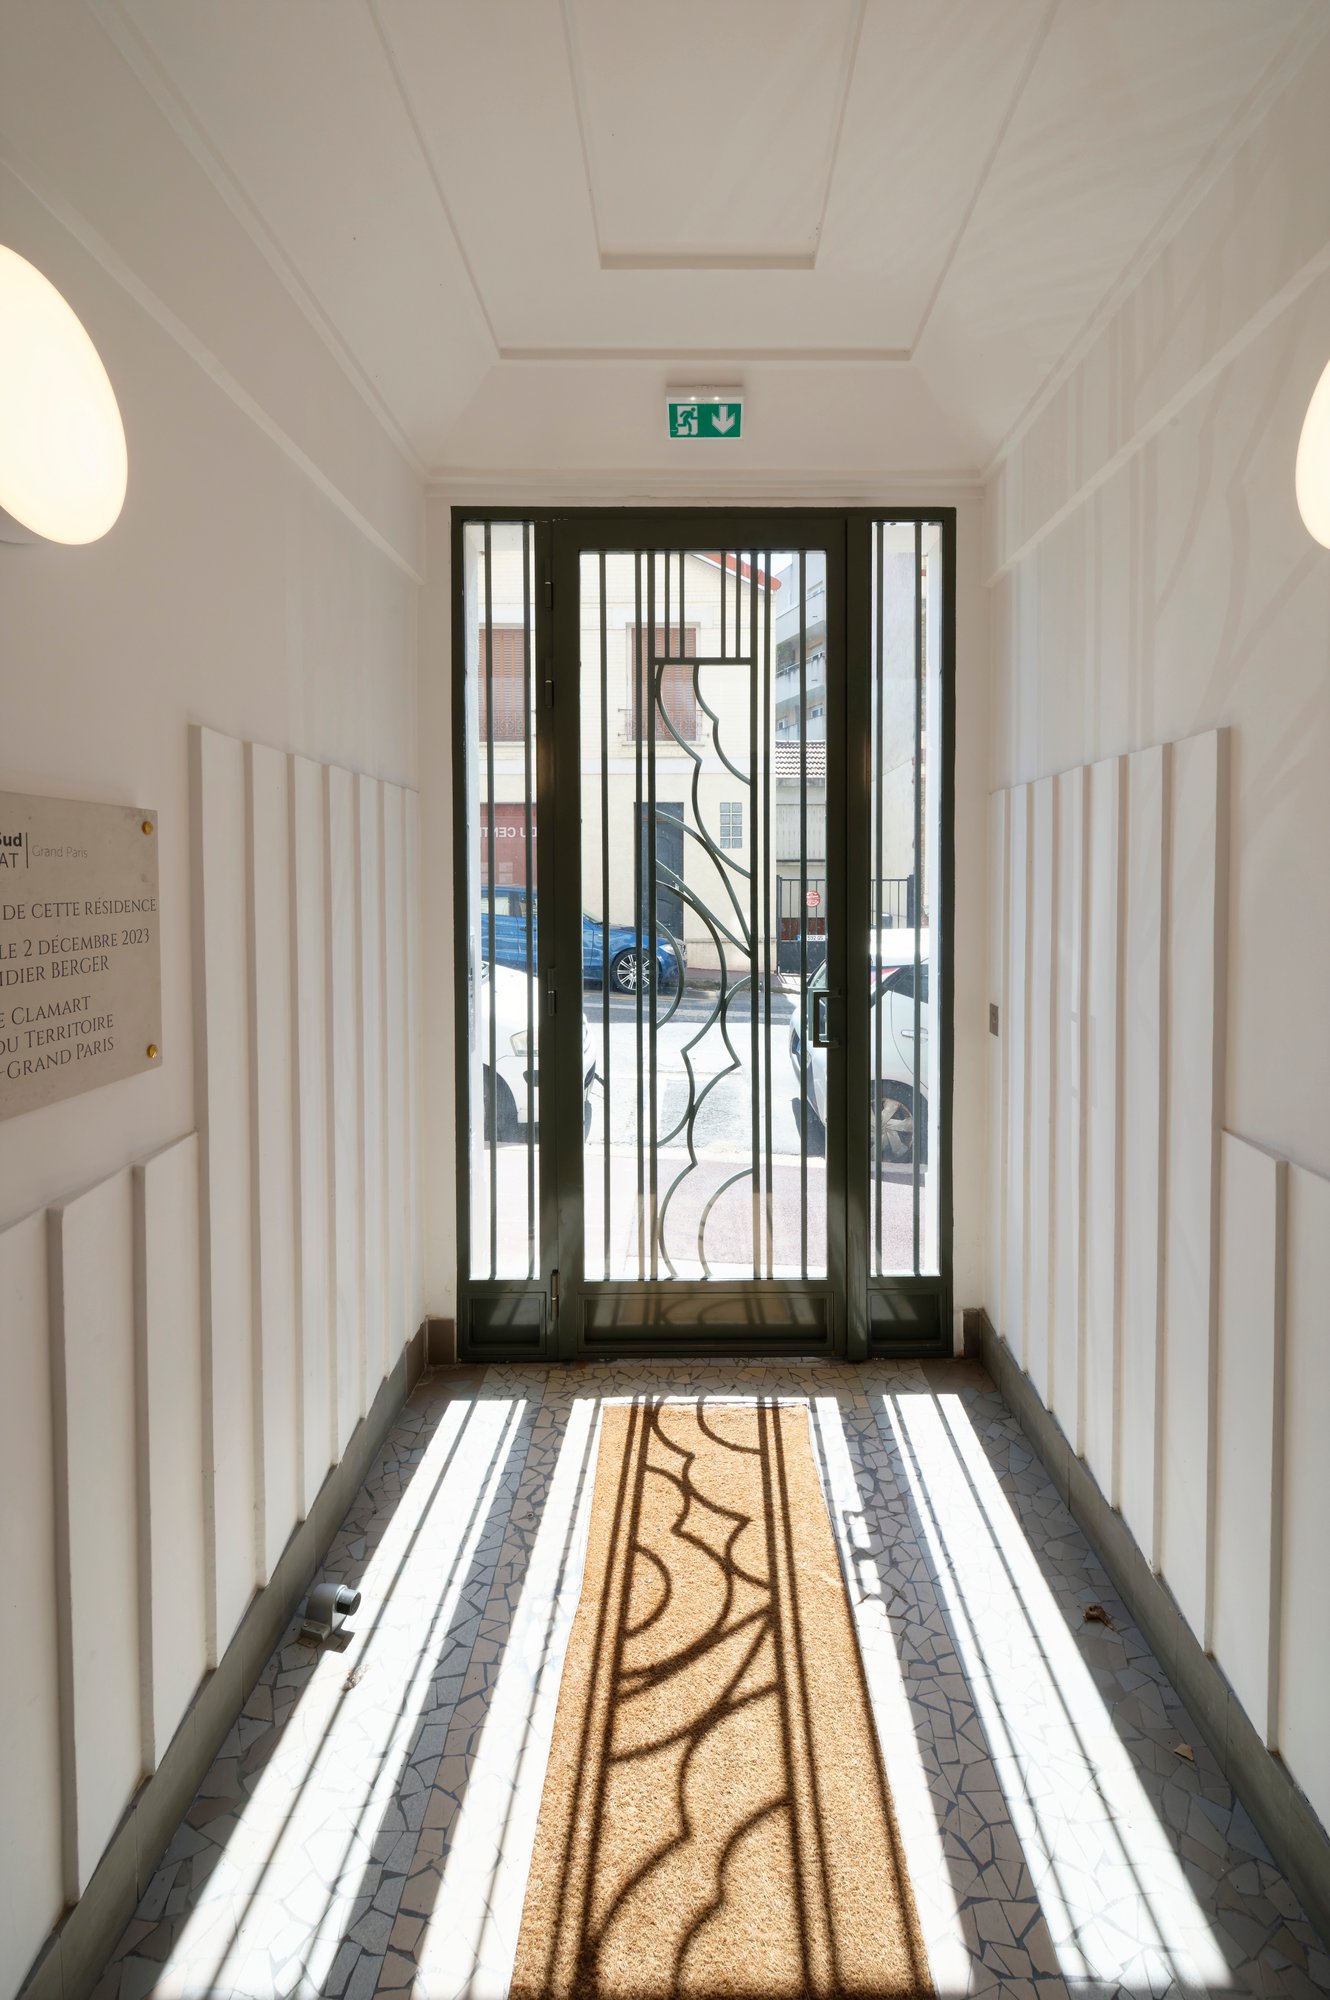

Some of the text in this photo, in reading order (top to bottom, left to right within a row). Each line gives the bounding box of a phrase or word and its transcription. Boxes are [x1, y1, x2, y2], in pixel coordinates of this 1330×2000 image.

[0, 832, 22, 847] ud
[32, 845, 88, 858] Grand Paris
[3, 897, 157, 921] DE CETTE RÉSIDENCE
[23, 939, 33, 958] 2
[38, 934, 118, 956] DÉCEMBRE
[121, 928, 150, 946] 2023
[51, 955, 110, 979] BERGER
[11, 995, 91, 1025] CLAMART
[24, 1014, 114, 1048] TERRITOIRE
[76, 1036, 114, 1060] PARIS
